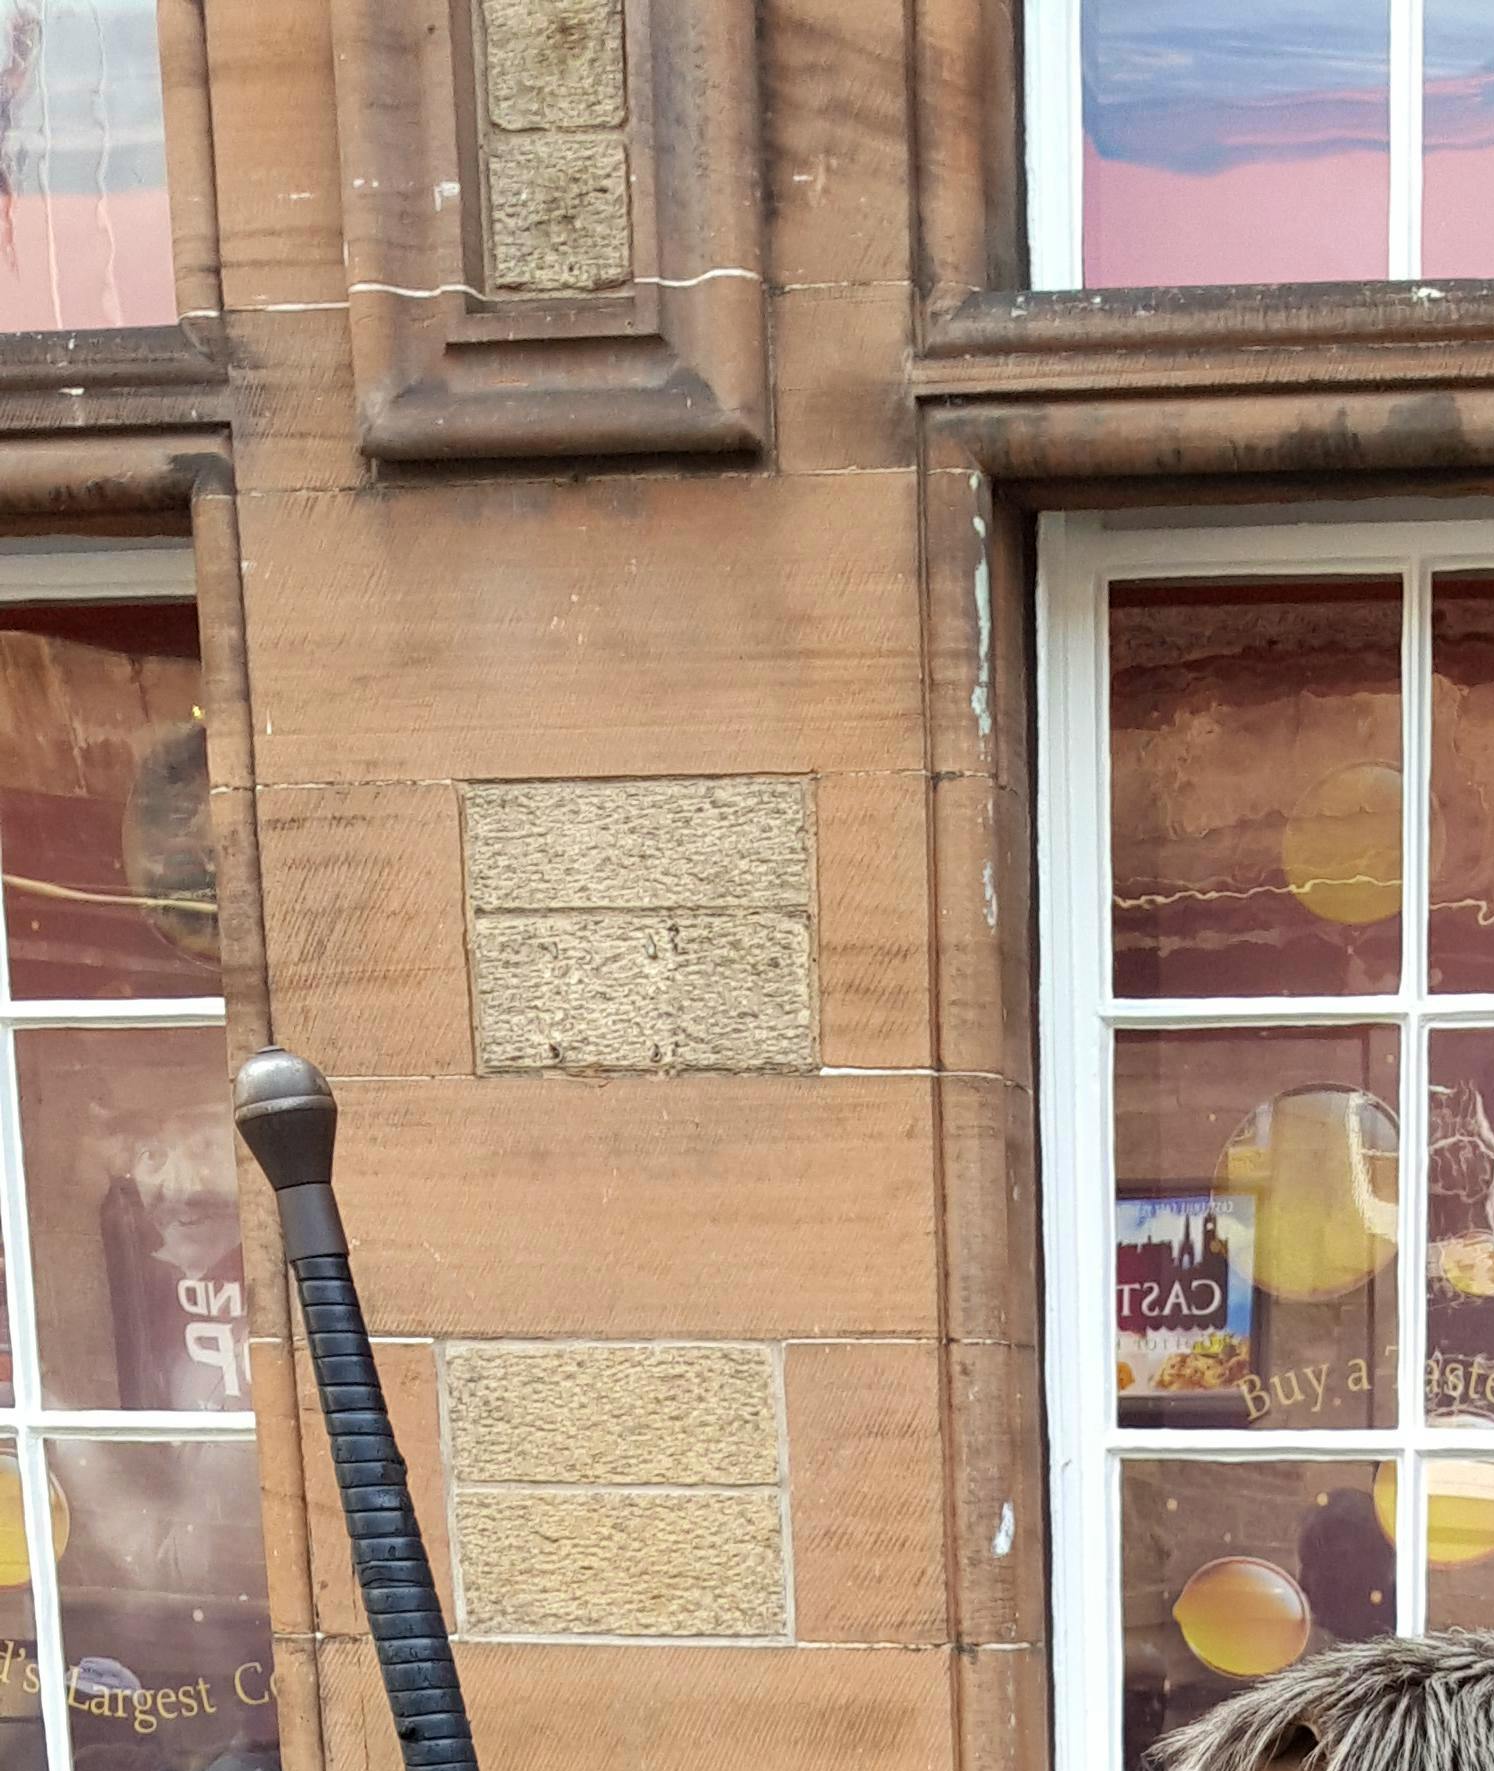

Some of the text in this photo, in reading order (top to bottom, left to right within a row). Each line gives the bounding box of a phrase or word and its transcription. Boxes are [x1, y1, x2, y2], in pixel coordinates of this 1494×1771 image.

[1235, 1358, 1331, 1423] Buy
[1346, 1353, 1371, 1392] a
[66, 1665, 217, 1734] Largest
